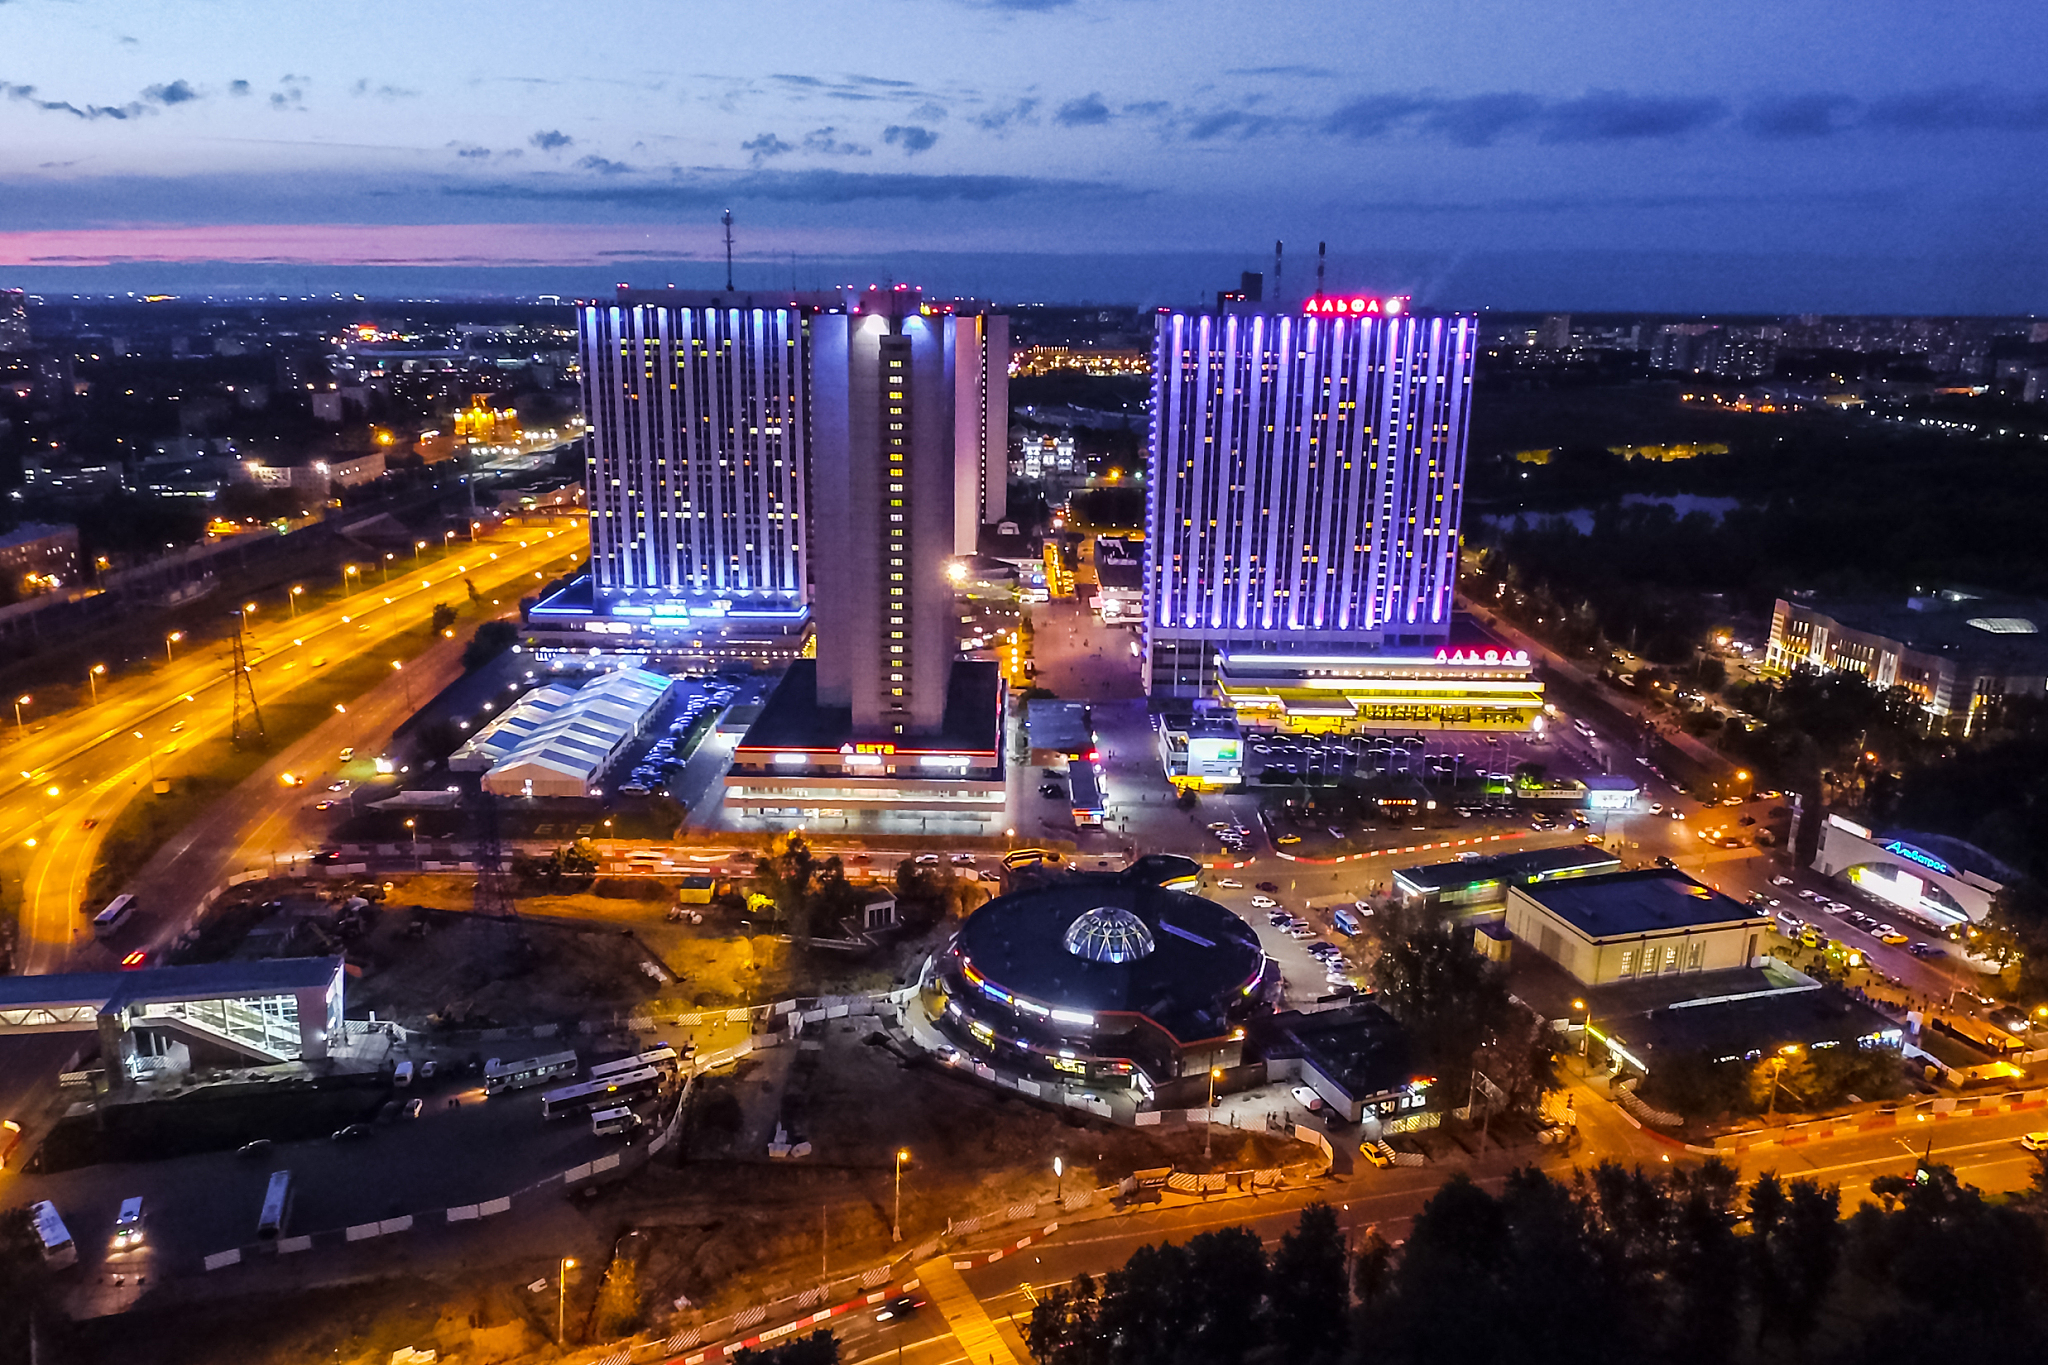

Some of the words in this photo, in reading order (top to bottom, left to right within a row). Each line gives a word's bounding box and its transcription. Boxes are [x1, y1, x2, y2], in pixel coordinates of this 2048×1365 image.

[1306, 299, 1379, 312] АЛЬФА
[1436, 650, 1515, 664] АЛЬФА
[855, 743, 895, 755] БЕТА
[1886, 841, 1947, 873] Альбатрос
